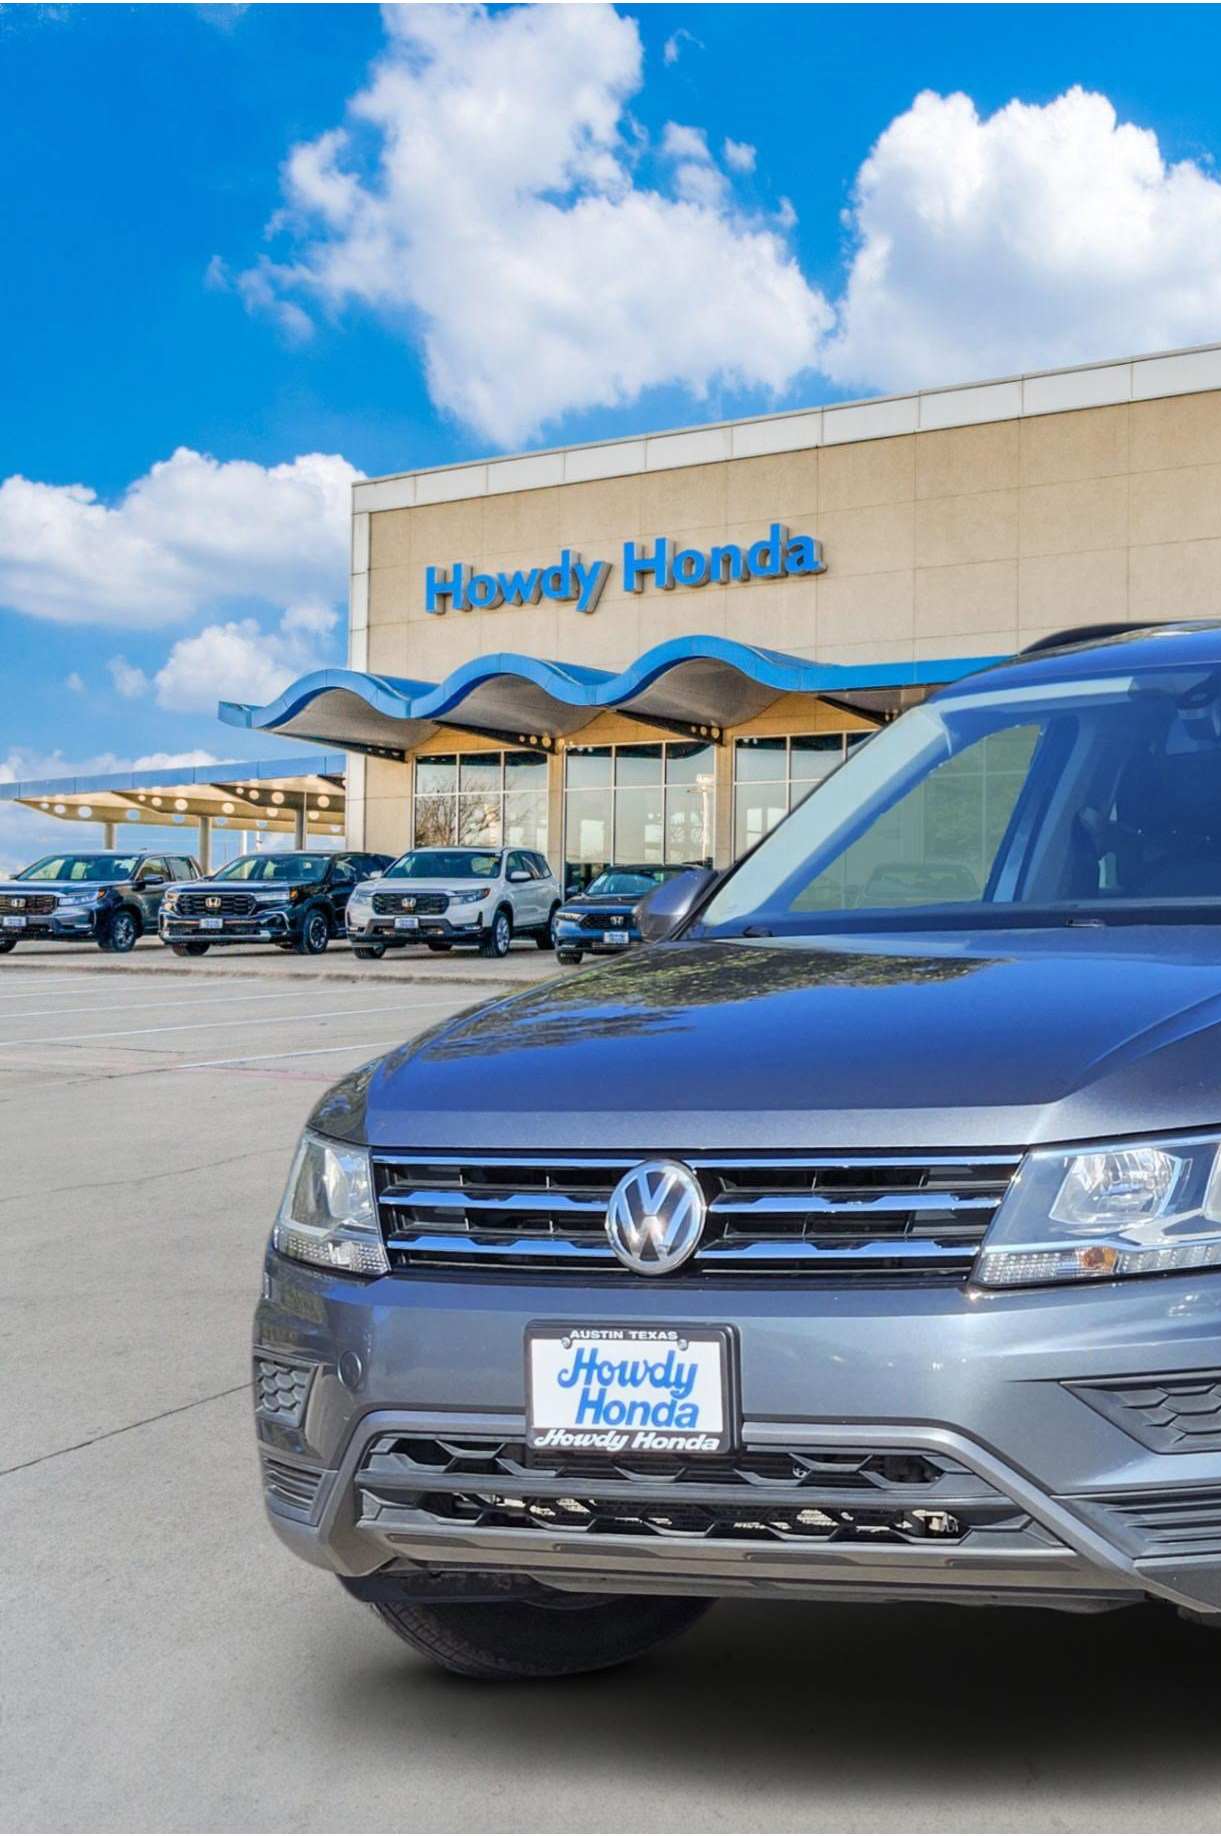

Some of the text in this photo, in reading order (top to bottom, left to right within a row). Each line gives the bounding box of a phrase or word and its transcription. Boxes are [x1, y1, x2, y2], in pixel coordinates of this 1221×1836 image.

[424, 522, 827, 614] Howdy Honda
[569, 1329, 679, 1341] AUSTIN TEXAS
[557, 1346, 699, 1400] Howdy
[574, 1386, 700, 1429] Honda
[533, 1428, 721, 1451] Howdy Honda
